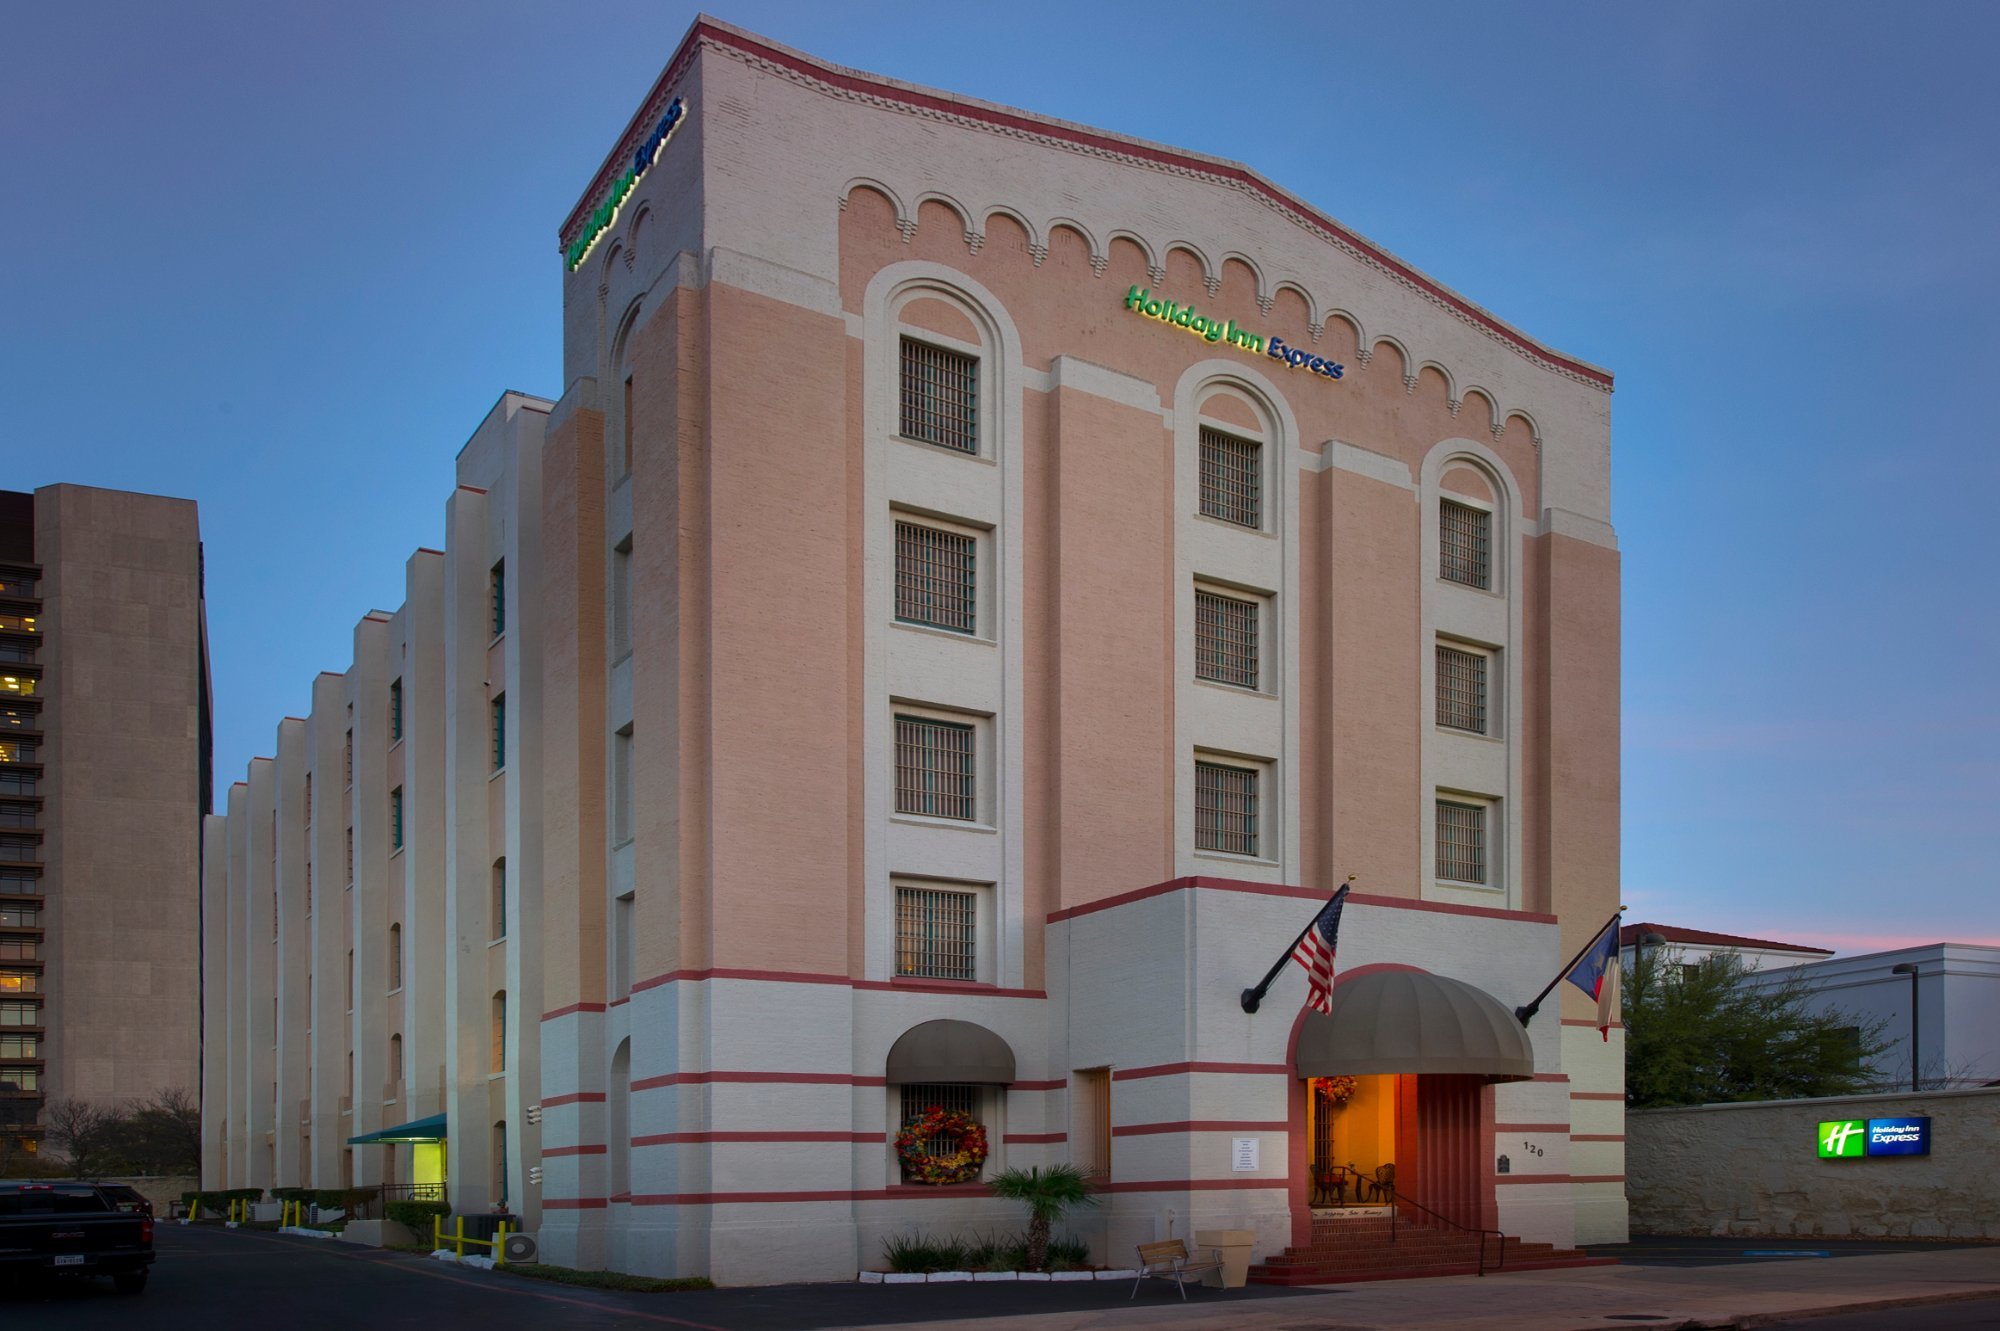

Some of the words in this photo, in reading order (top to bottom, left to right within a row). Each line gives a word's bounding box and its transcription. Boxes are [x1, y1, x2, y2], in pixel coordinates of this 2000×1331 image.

[1126, 284, 1223, 342] Holiday
[1227, 319, 1265, 353] Inn
[1267, 336, 1345, 380] Express
[1872, 1126, 1905, 1134] Holiday
[1872, 1133, 1919, 1144] Express
[1523, 1141, 1544, 1157] 120
